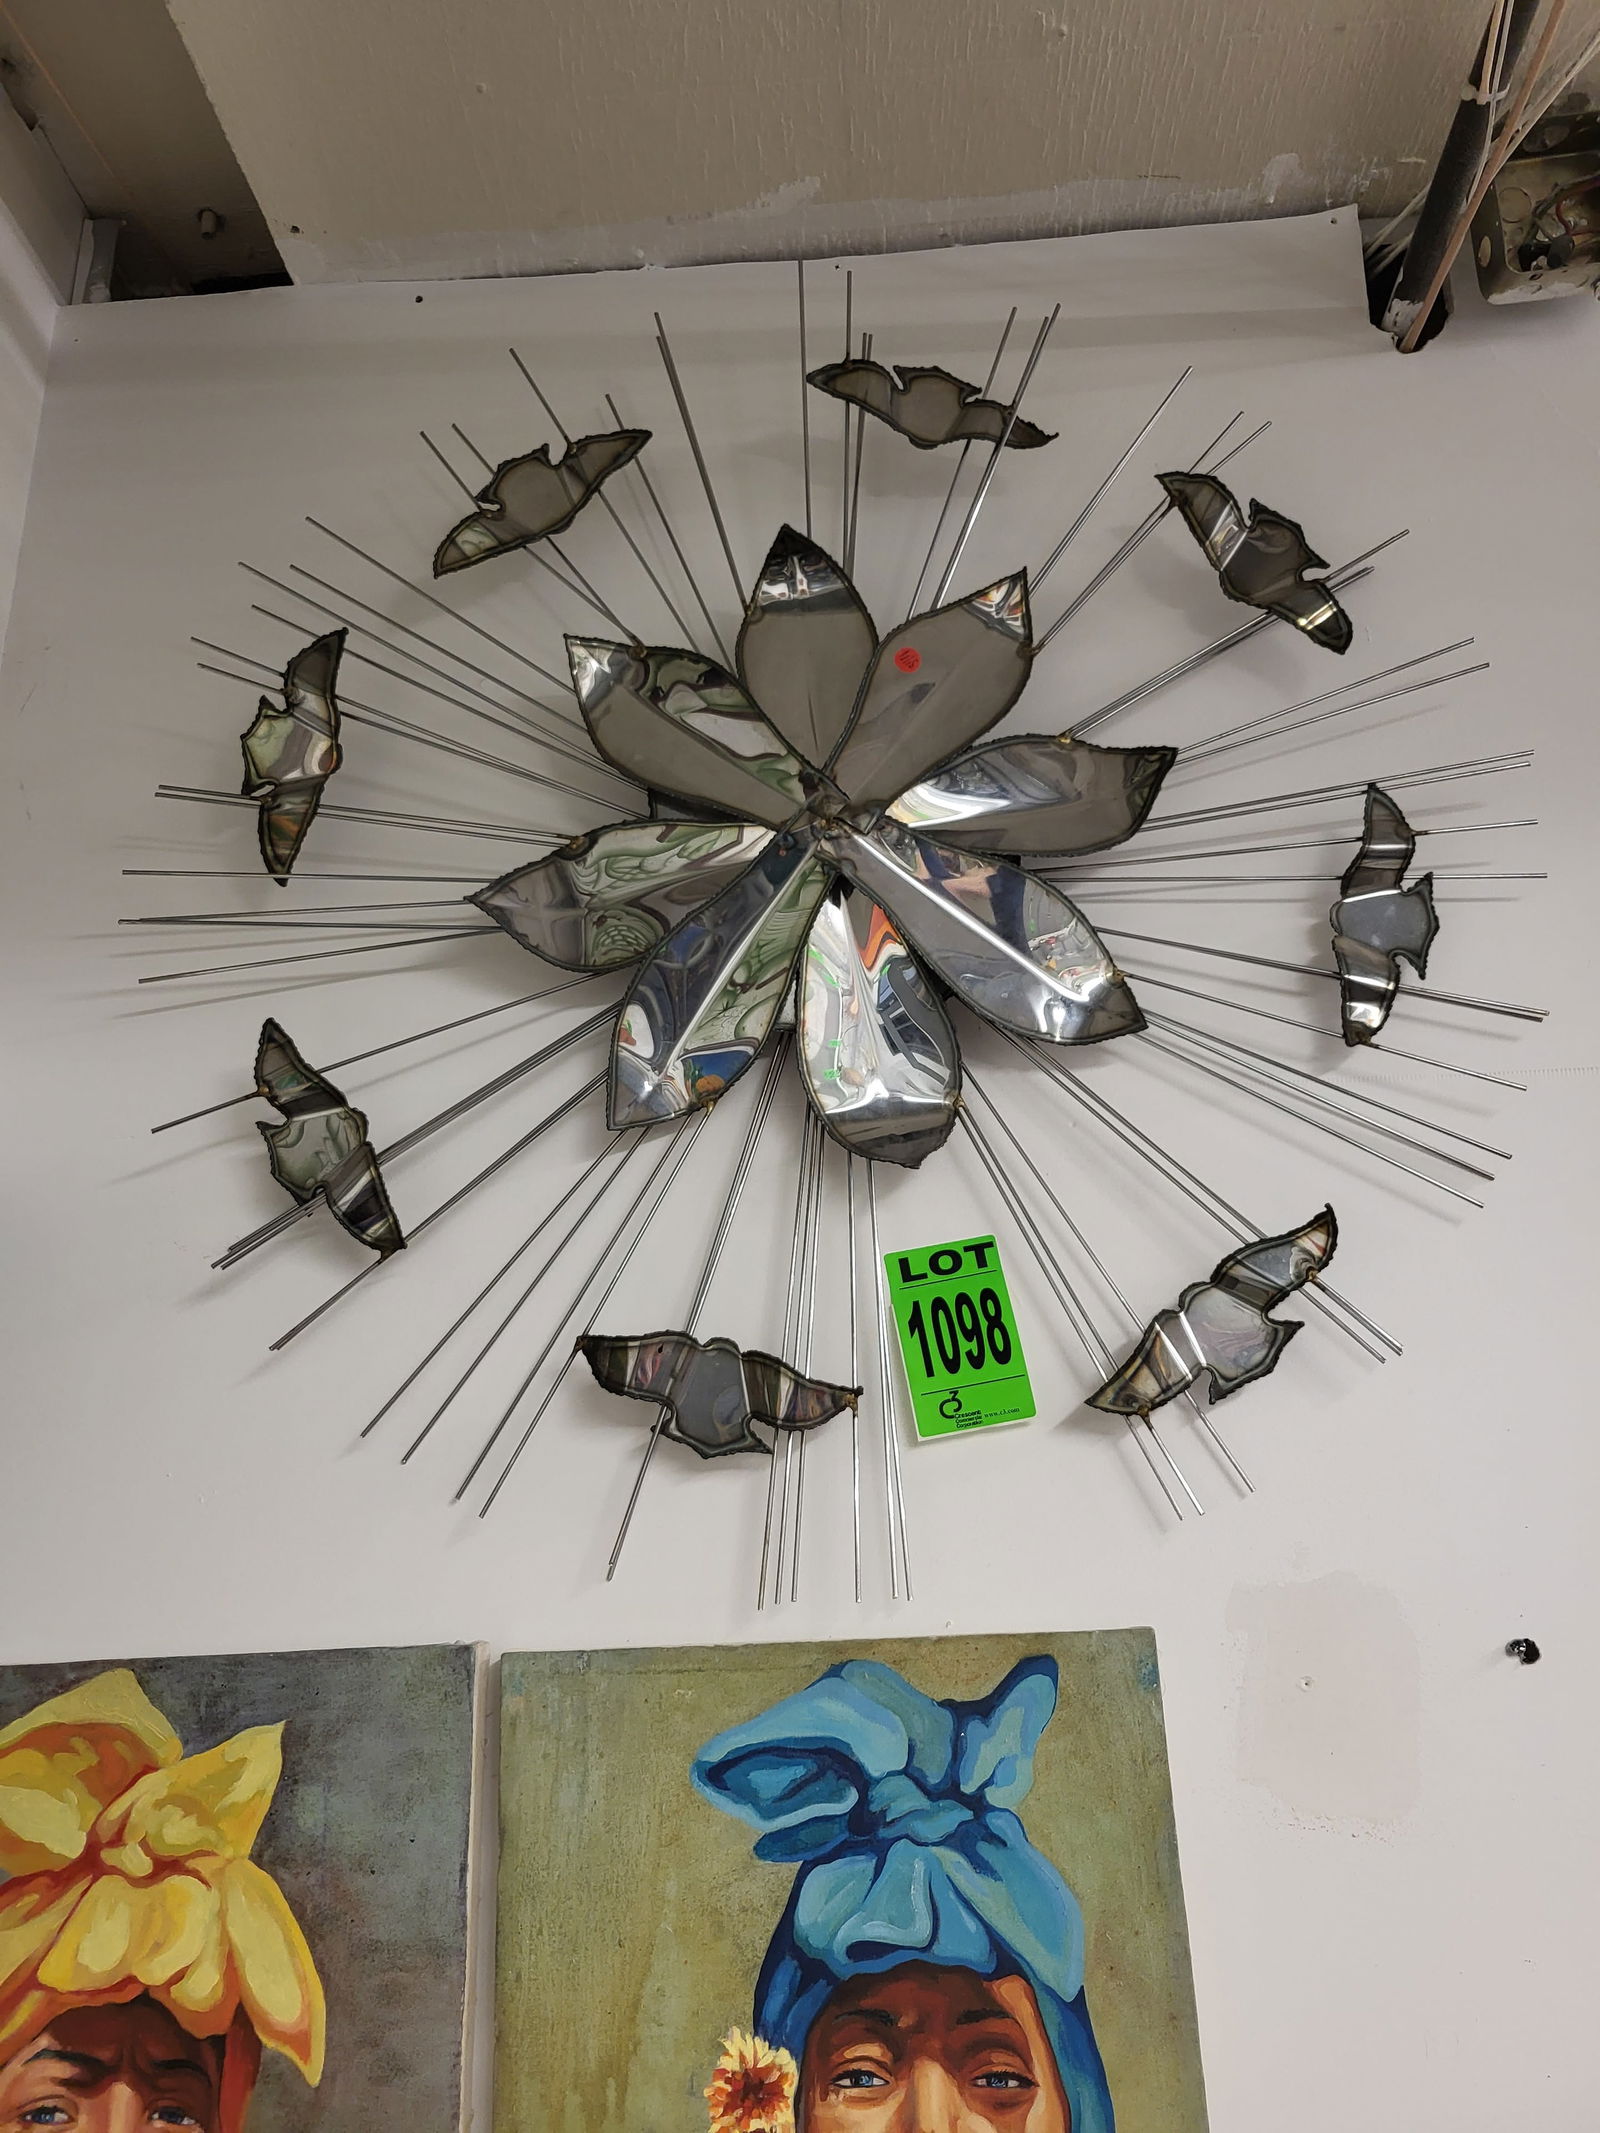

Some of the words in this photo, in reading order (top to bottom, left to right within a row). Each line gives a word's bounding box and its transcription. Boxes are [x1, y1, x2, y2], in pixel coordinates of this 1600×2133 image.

[898, 1241, 994, 1283] LOT
[908, 1288, 1012, 1378] 1098
[954, 1410, 982, 1419] Crescent
